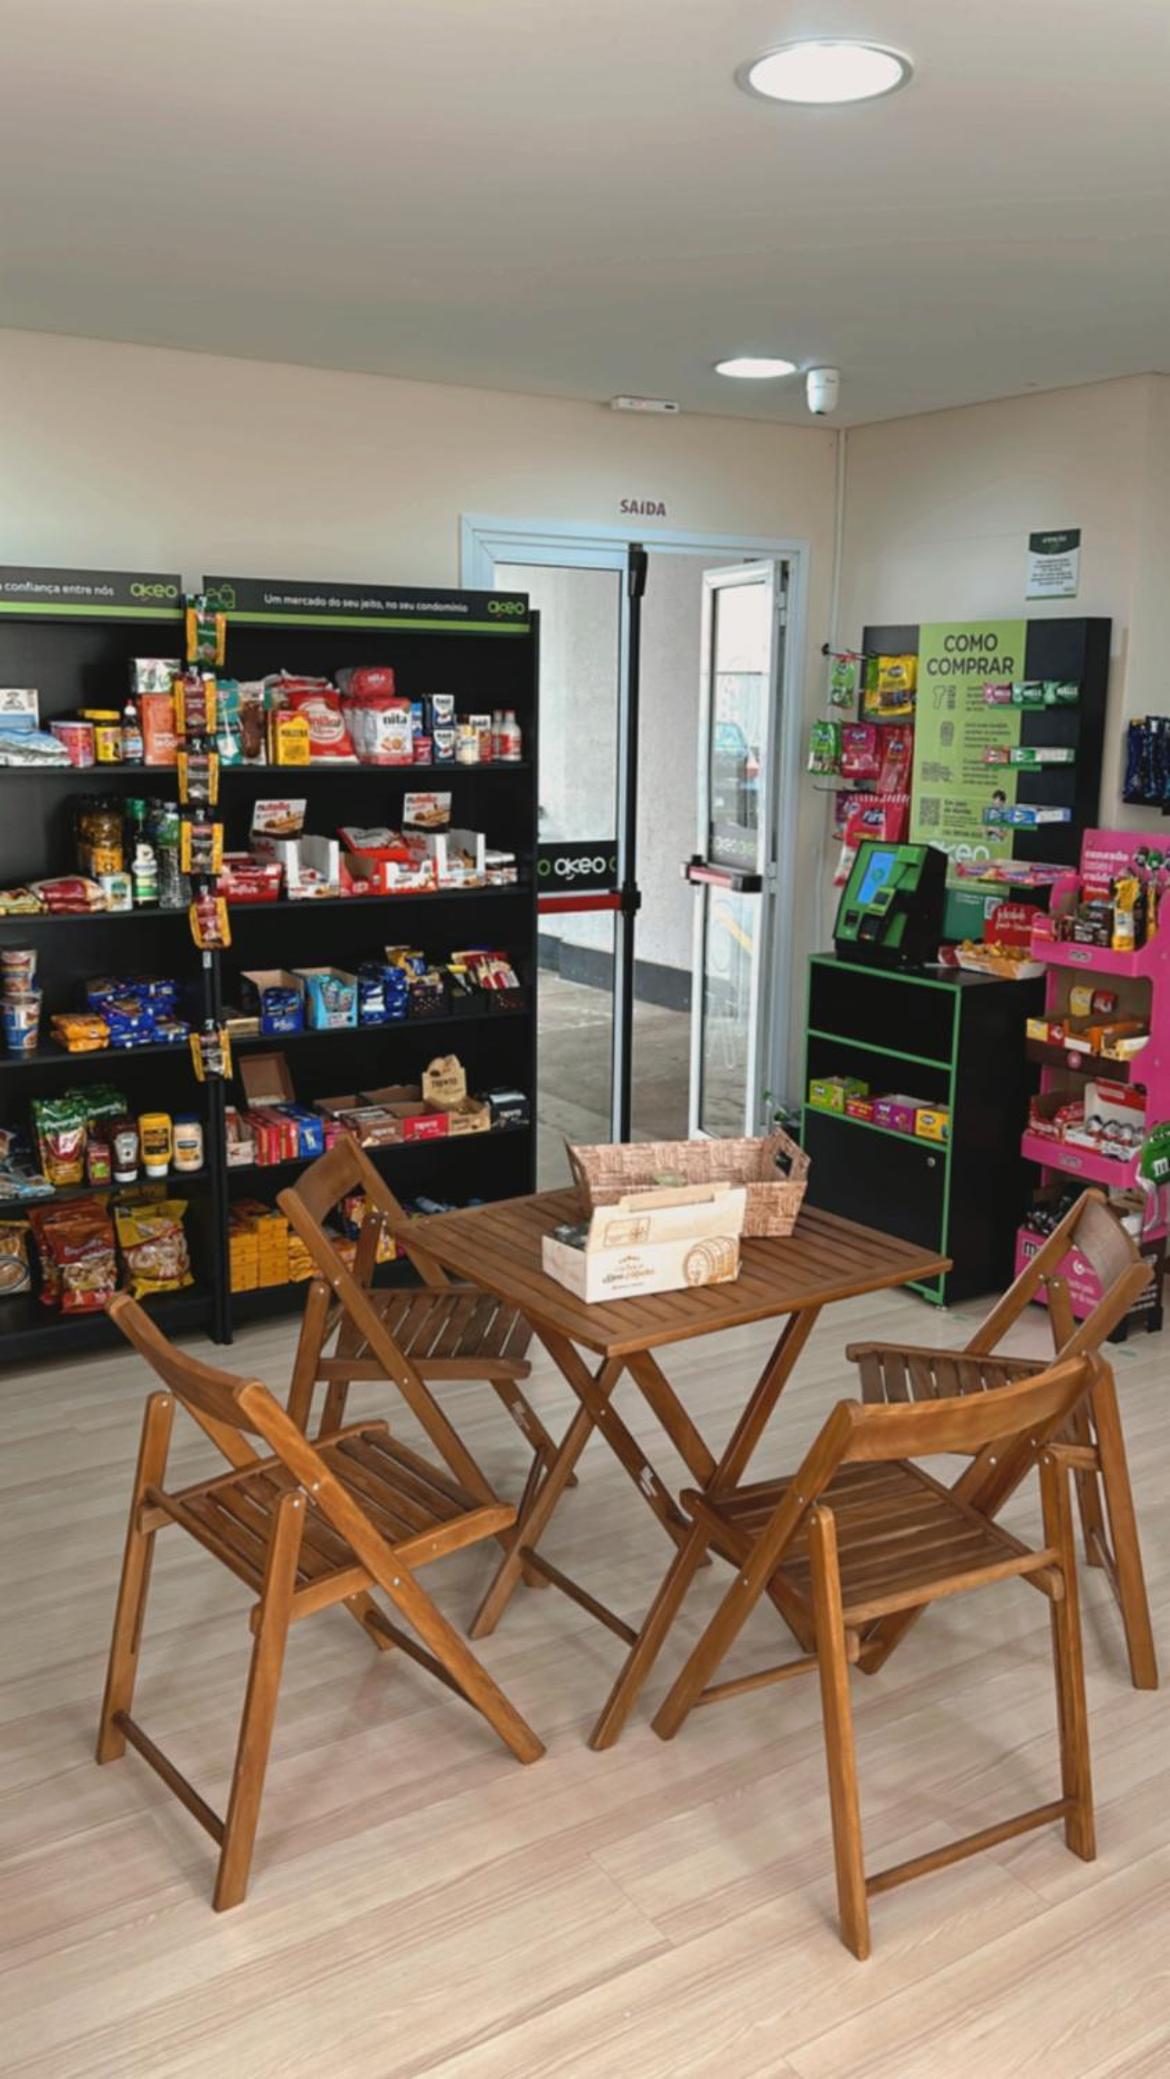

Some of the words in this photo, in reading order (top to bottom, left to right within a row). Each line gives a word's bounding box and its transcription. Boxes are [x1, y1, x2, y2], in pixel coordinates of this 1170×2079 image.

[4, 581, 60, 595] confiança
[62, 585, 92, 595] entre
[94, 585, 114, 596] nós
[284, 596, 327, 607] mercado
[944, 633, 998, 652] COMO
[927, 656, 1014, 676] COMPRAR
[383, 714, 407, 725] nita
